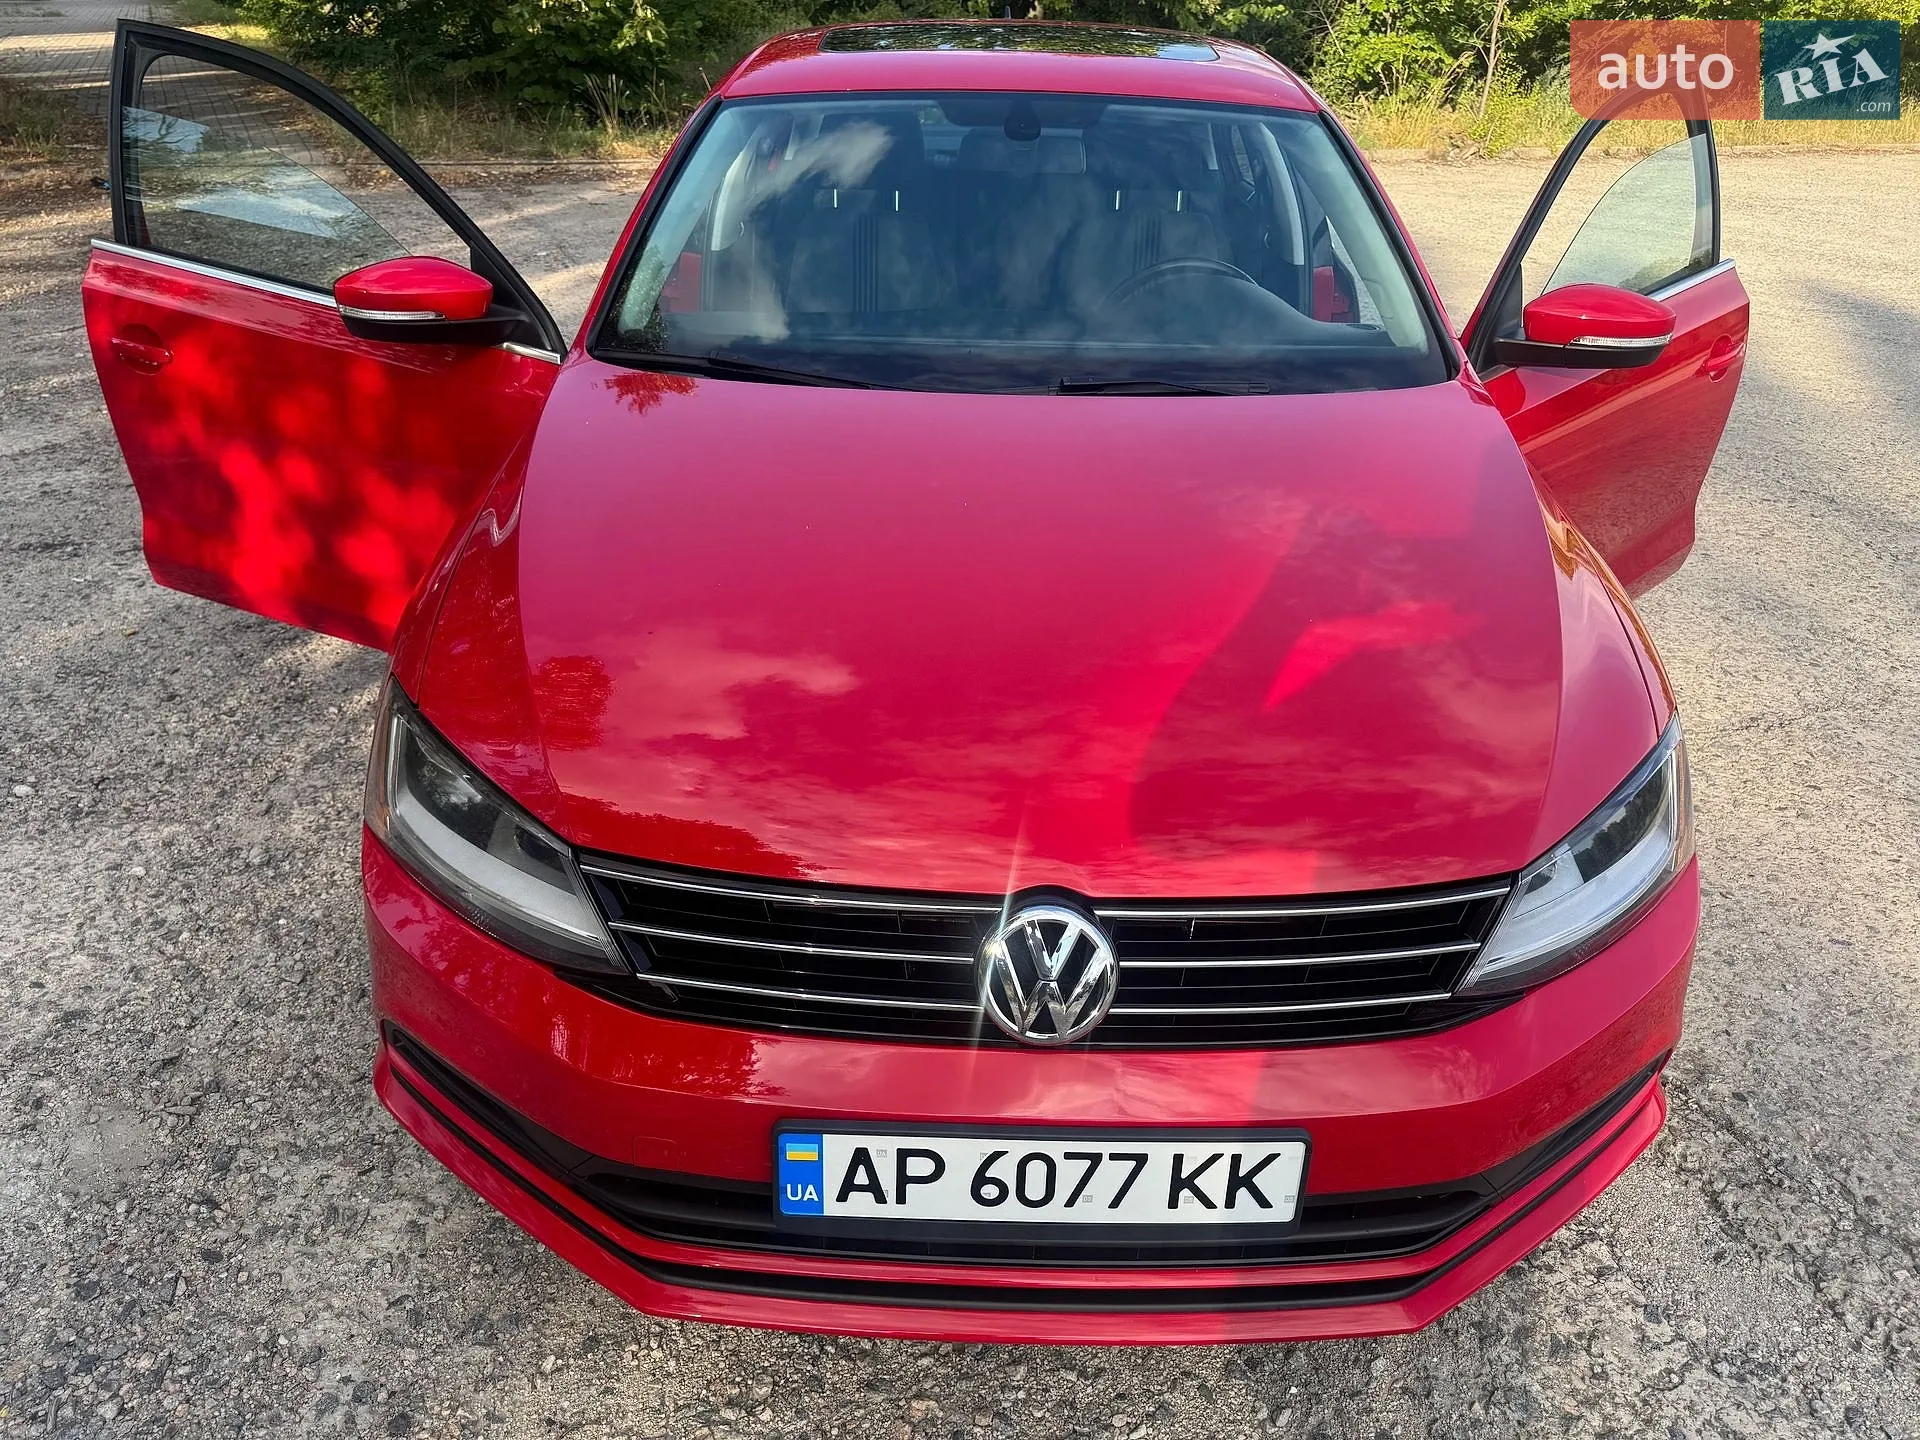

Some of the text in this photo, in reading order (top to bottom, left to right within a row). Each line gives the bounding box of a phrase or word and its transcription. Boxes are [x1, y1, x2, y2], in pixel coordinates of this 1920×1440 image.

[984, 918, 1112, 1038] VW
[786, 1183, 819, 1202] UA
[835, 1146, 1281, 1210] AP 6077 KK
